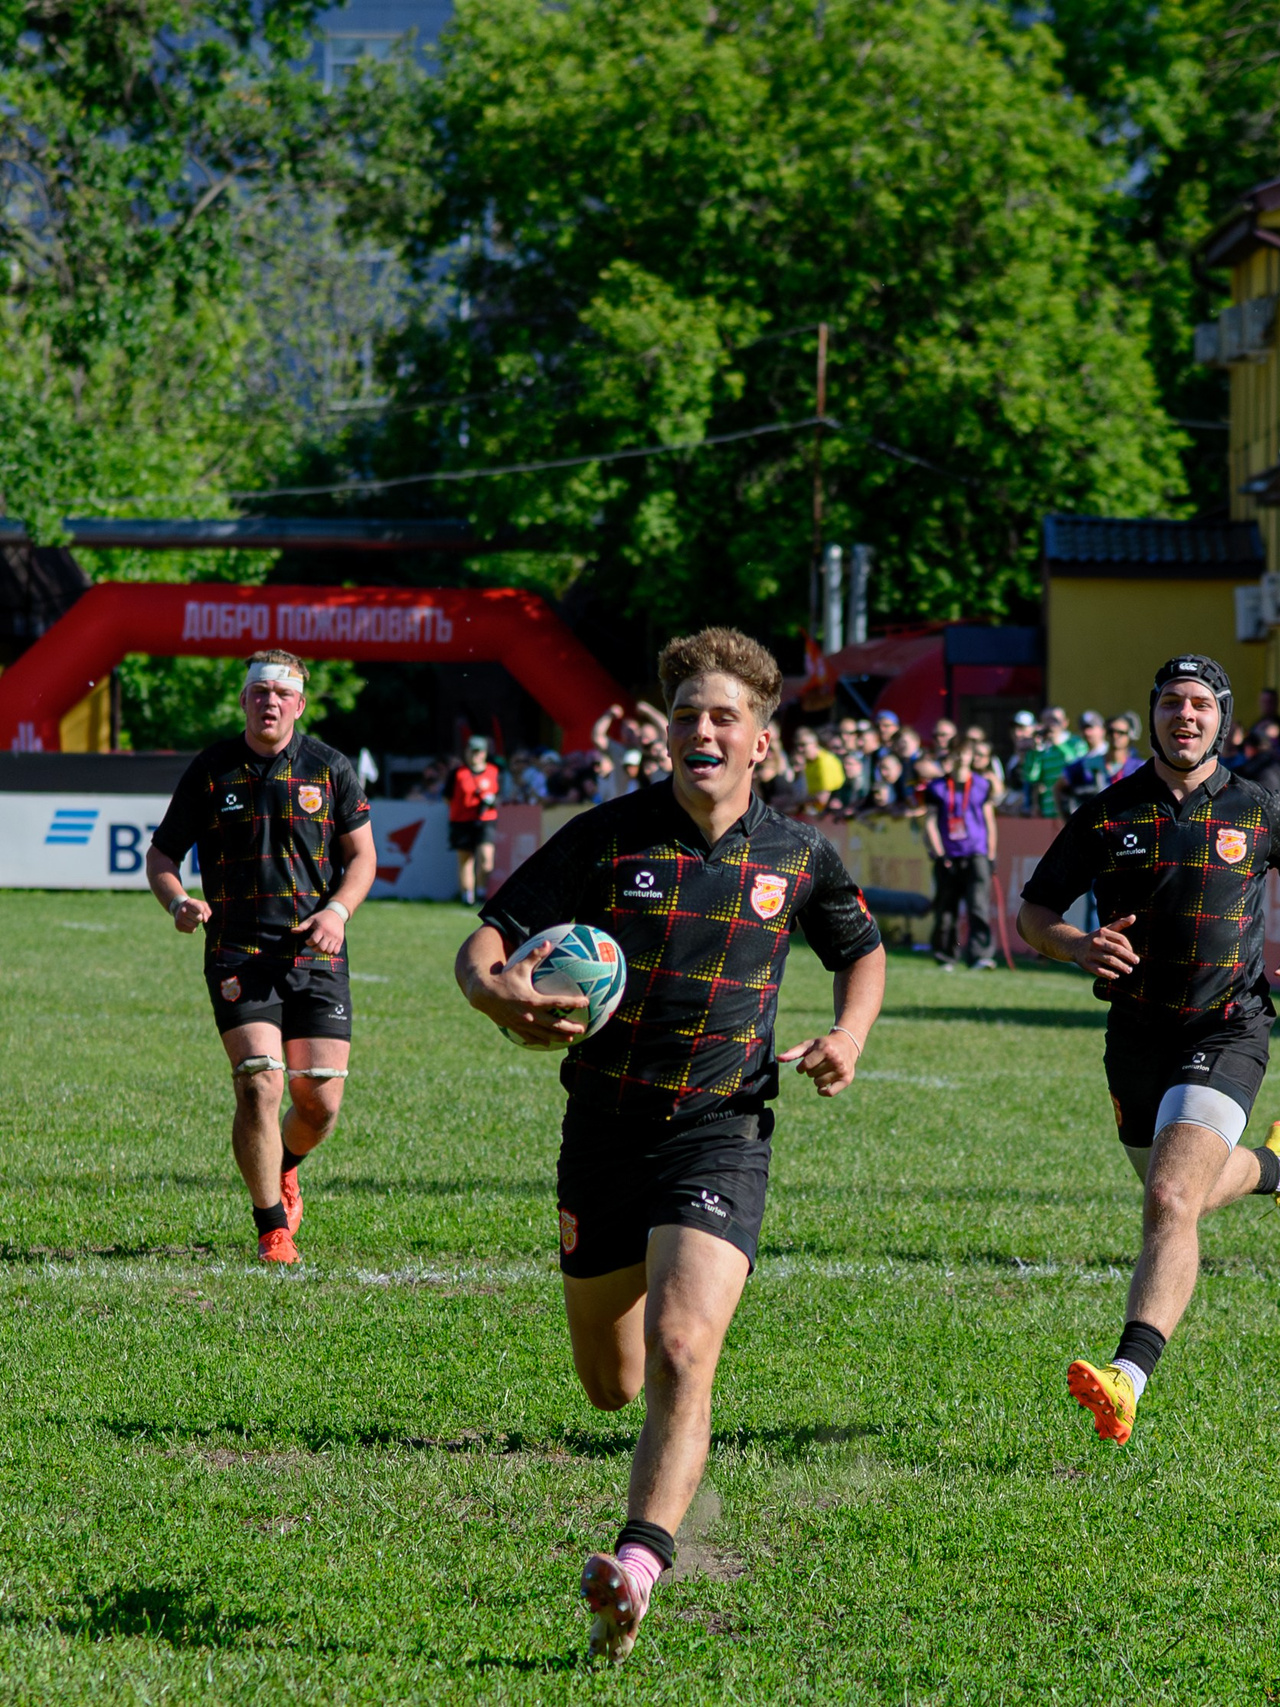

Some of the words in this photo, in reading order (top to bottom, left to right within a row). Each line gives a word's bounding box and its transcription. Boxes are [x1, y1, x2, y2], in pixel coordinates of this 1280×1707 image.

[183, 602, 269, 641] ДОБРО
[277, 603, 452, 642] ПОЖАЛОВАТЬ
[623, 890, 662, 899] centurion
